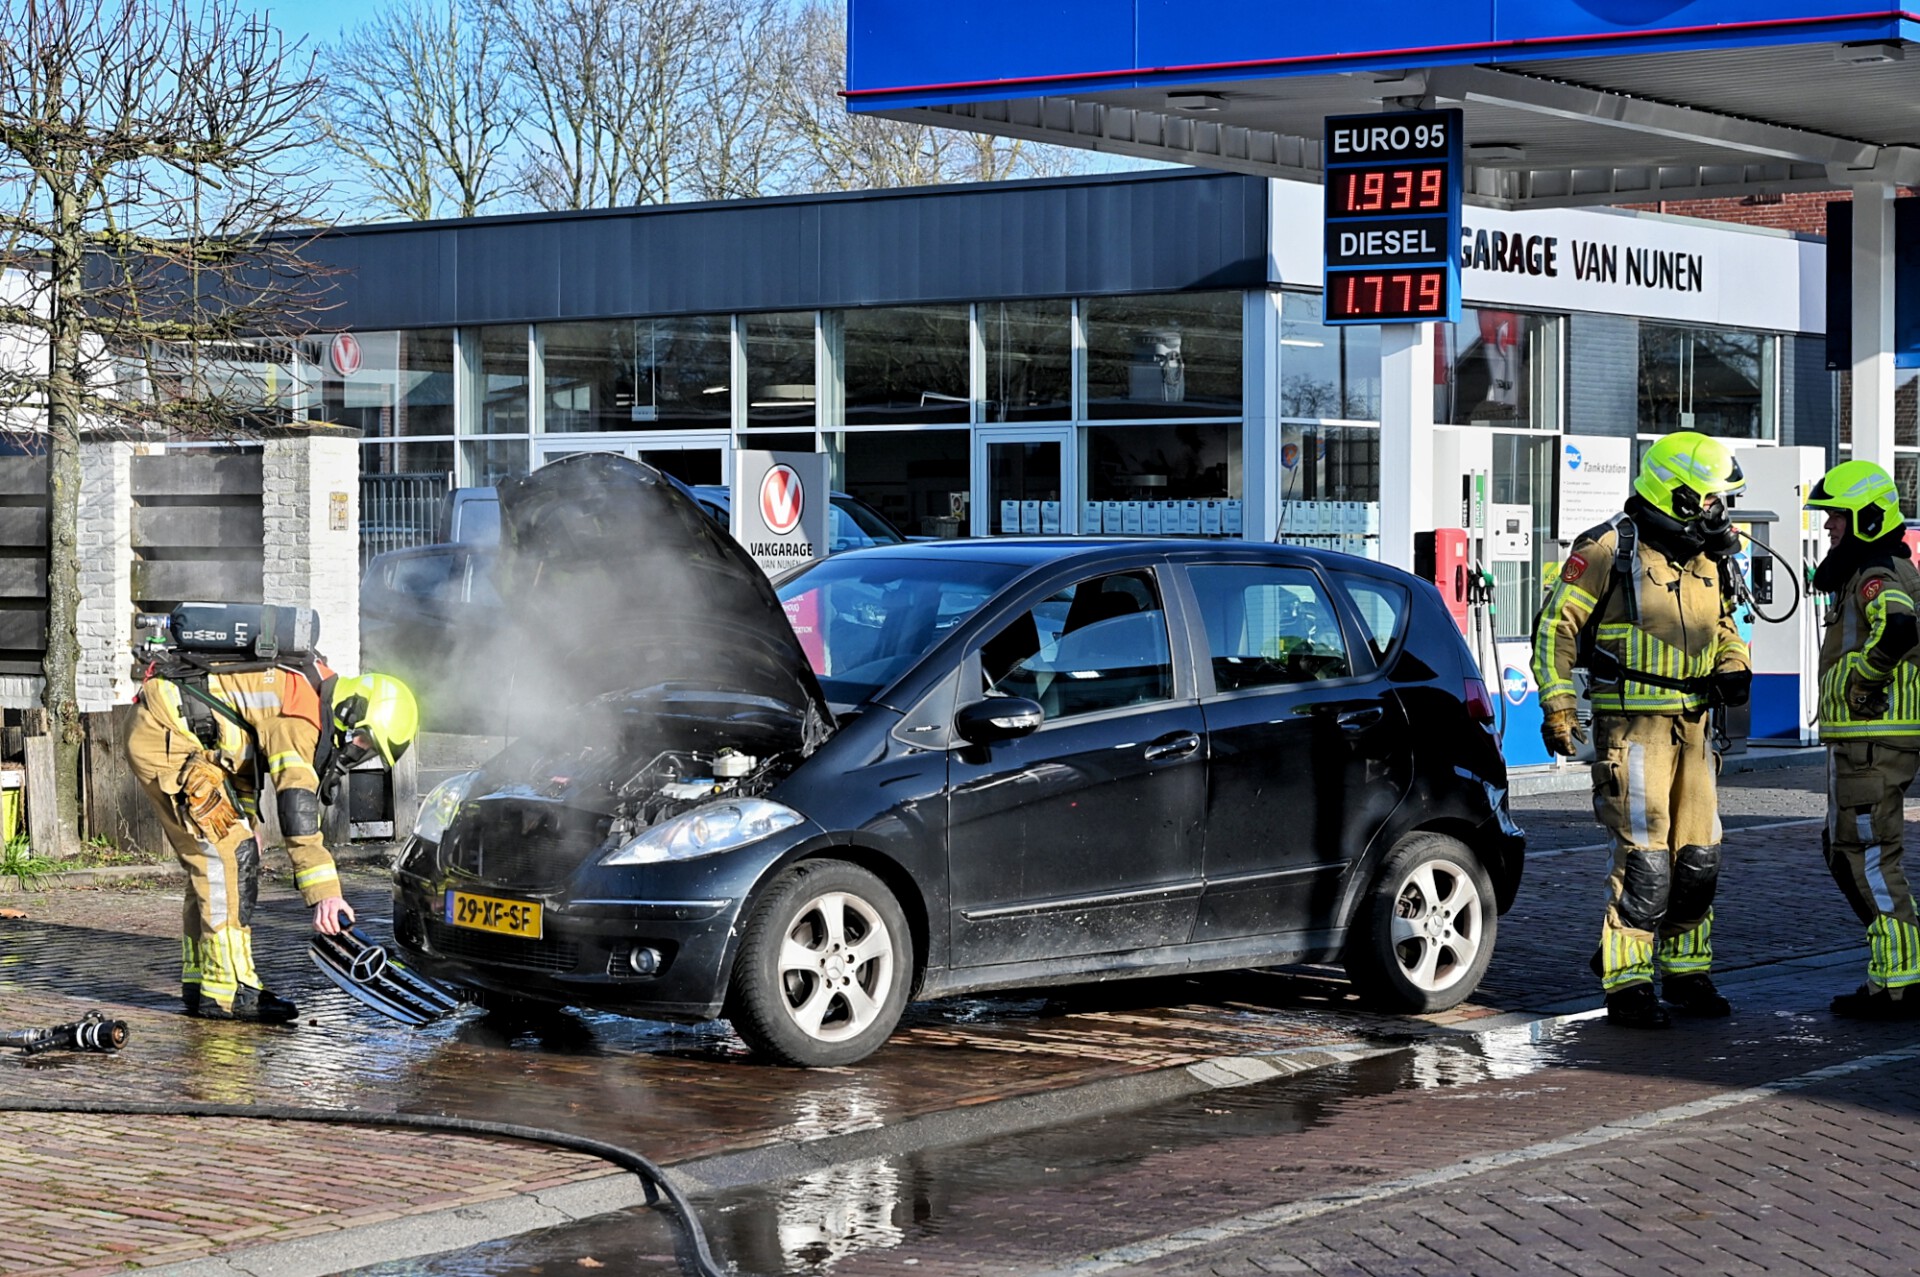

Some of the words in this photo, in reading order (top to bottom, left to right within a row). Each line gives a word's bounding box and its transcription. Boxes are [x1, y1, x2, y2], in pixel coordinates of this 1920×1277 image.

[1334, 126, 1410, 153] EURO
[1414, 124, 1444, 149] 95
[1347, 170, 1441, 211] 1.939
[1340, 230, 1436, 256] DIESEL
[1572, 239, 1618, 284] VAN
[1626, 246, 1703, 293] NUNEN
[1346, 274, 1440, 314] 1.779
[1584, 462, 1627, 474] Tankstation
[1794, 485, 1800, 497] 1
[750, 543, 813, 557] VAKGARAGE
[1524, 532, 1530, 546] 3
[761, 560, 776, 569] VAN
[457, 896, 532, 931] 29-XF-SF
